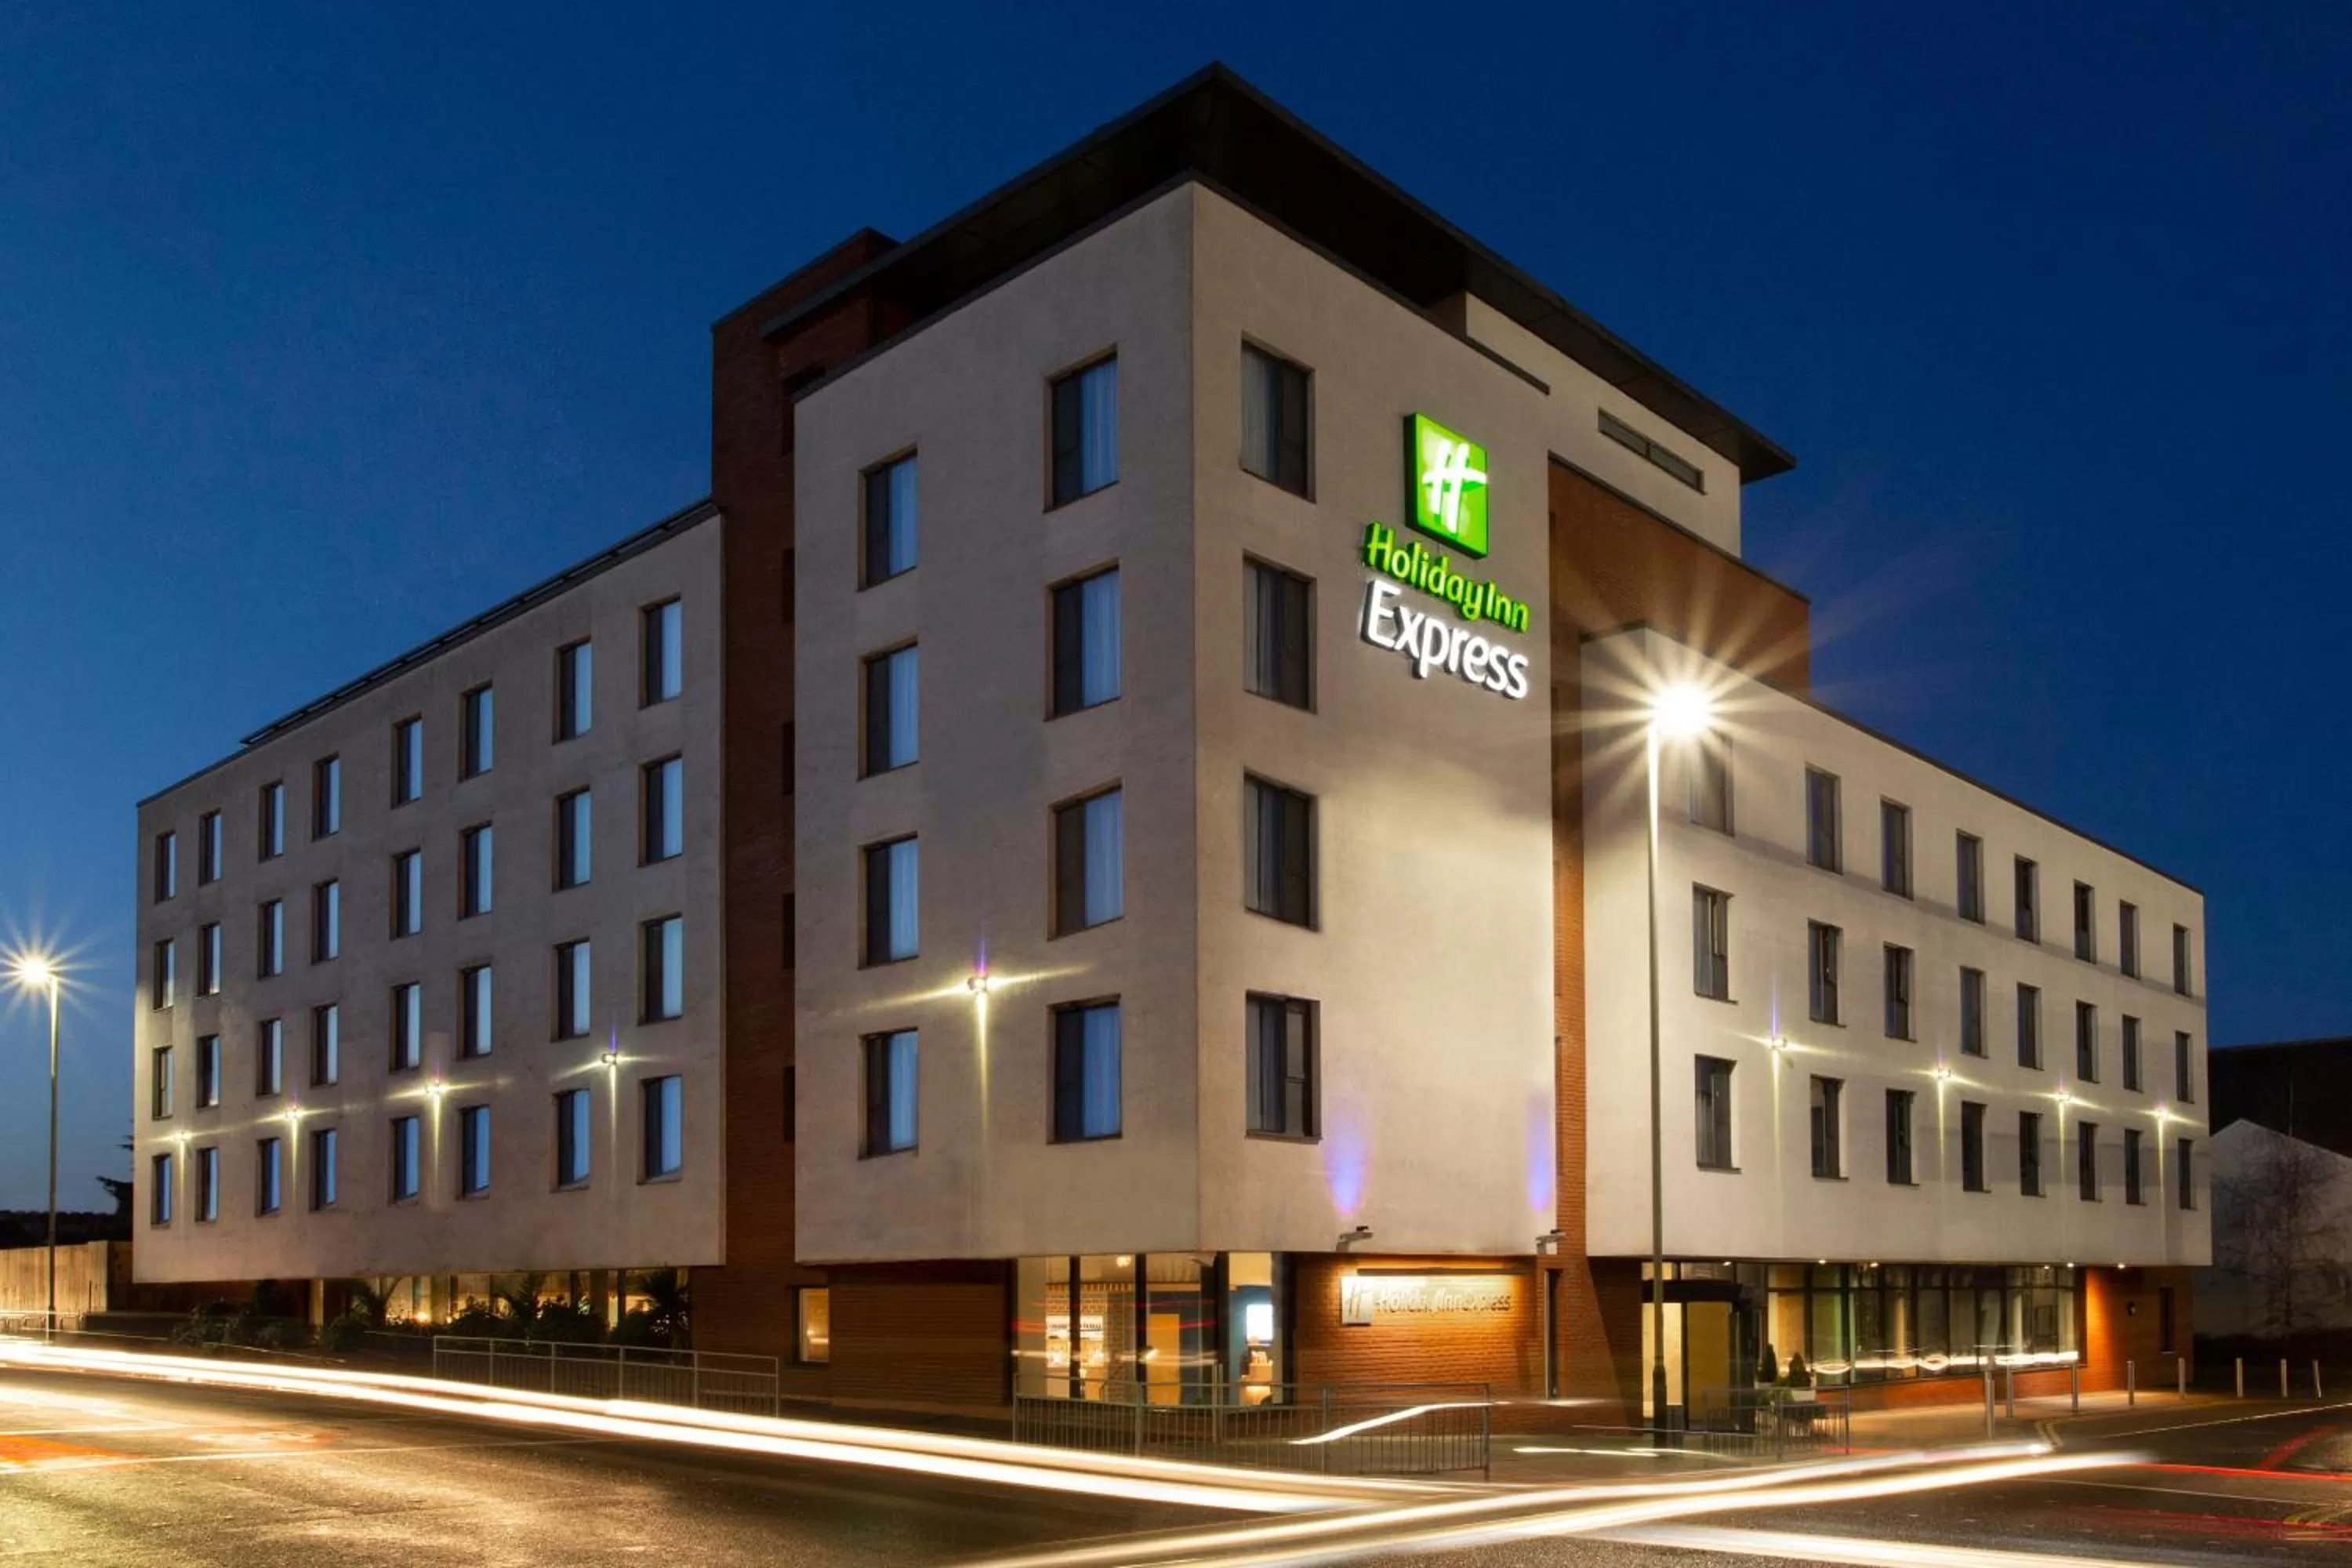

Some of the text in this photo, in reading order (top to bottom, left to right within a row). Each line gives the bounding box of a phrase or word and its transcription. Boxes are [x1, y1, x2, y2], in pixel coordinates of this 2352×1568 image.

[1364, 521, 1530, 633] Holiday Inn
[1361, 579, 1529, 700] Express
